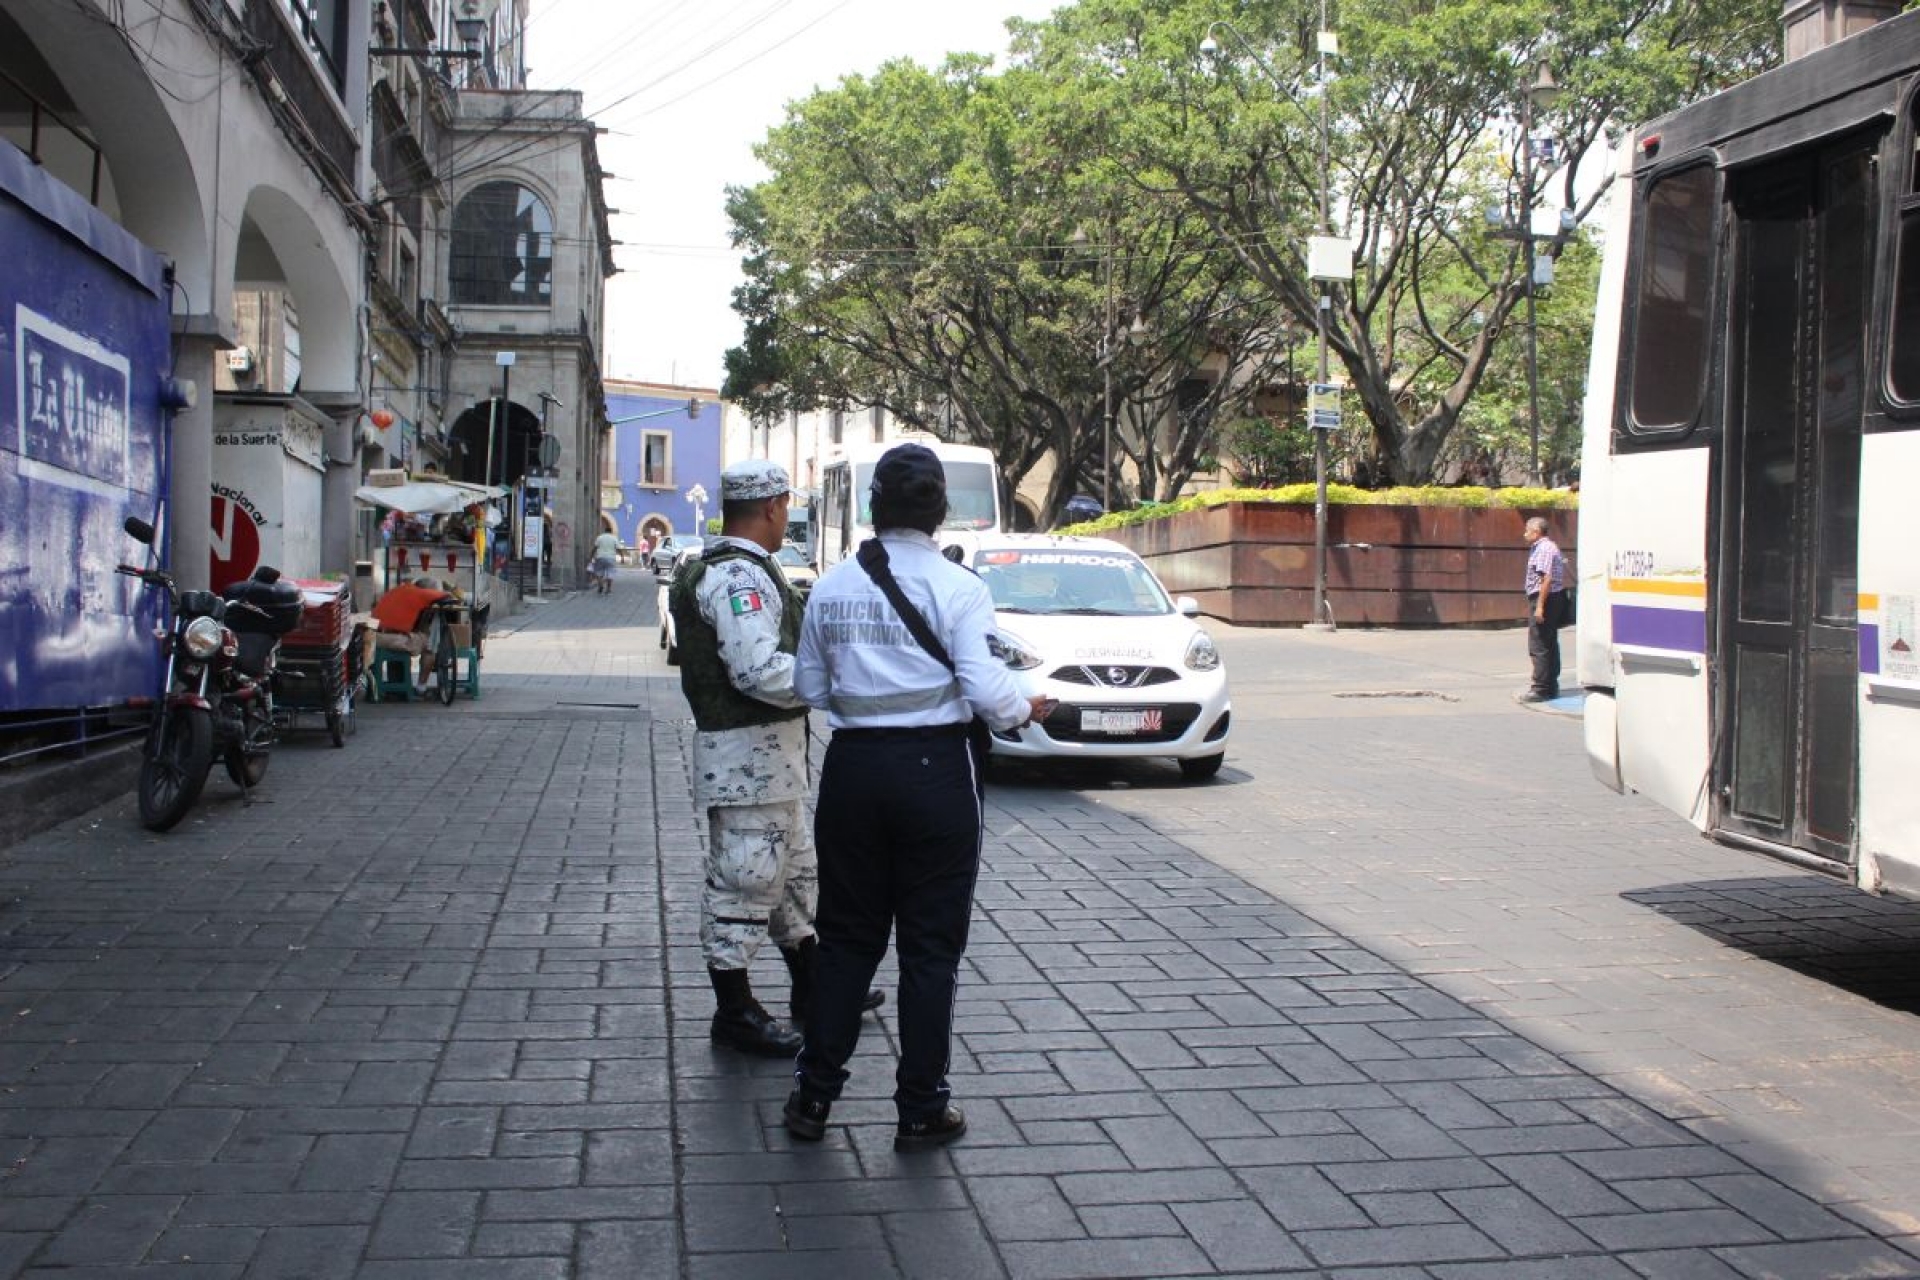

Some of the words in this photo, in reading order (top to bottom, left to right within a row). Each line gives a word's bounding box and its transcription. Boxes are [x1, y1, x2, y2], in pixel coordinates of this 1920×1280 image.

[29, 350, 59, 432] La
[215, 433, 228, 446] de
[230, 431, 239, 446] la
[211, 482, 268, 526] Nacional
[821, 623, 916, 647] CUERNAVAC
